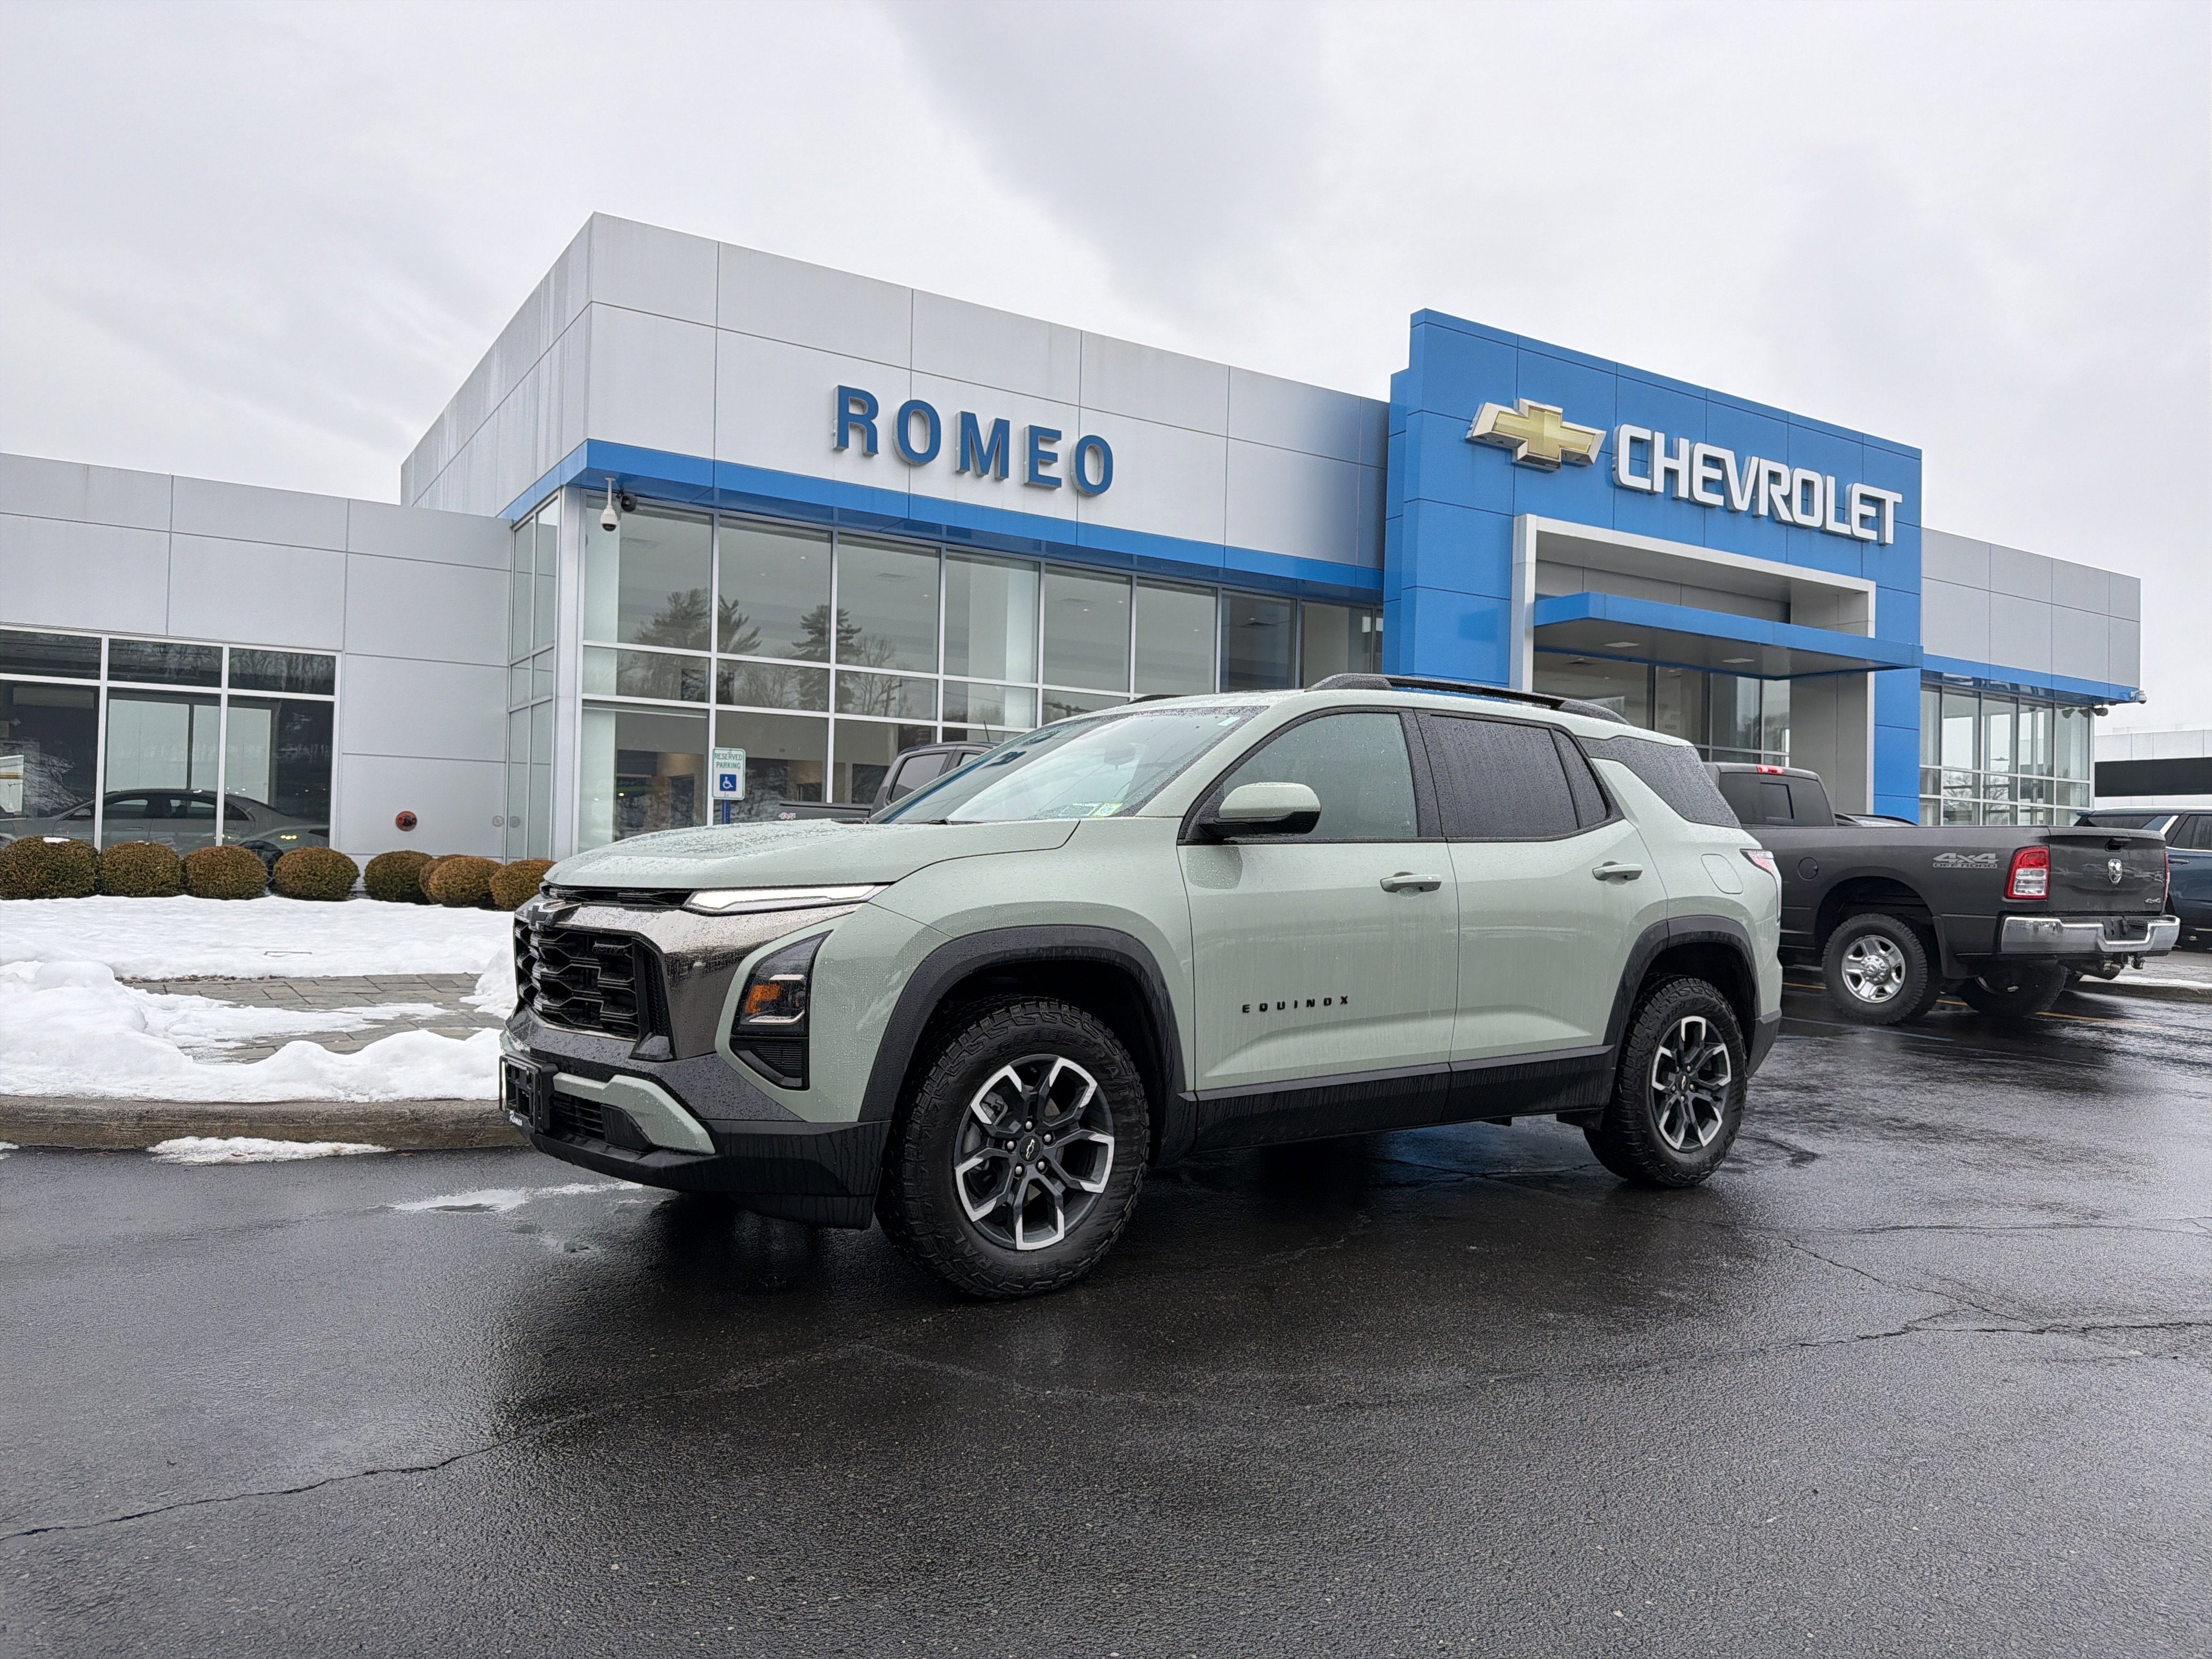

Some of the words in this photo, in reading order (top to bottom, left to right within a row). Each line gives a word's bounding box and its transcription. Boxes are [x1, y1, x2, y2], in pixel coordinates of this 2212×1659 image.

[833, 385, 1113, 495] ROMEO
[1612, 424, 1903, 545] CHEVROLET
[1242, 996, 1348, 1013] EQUINOX
